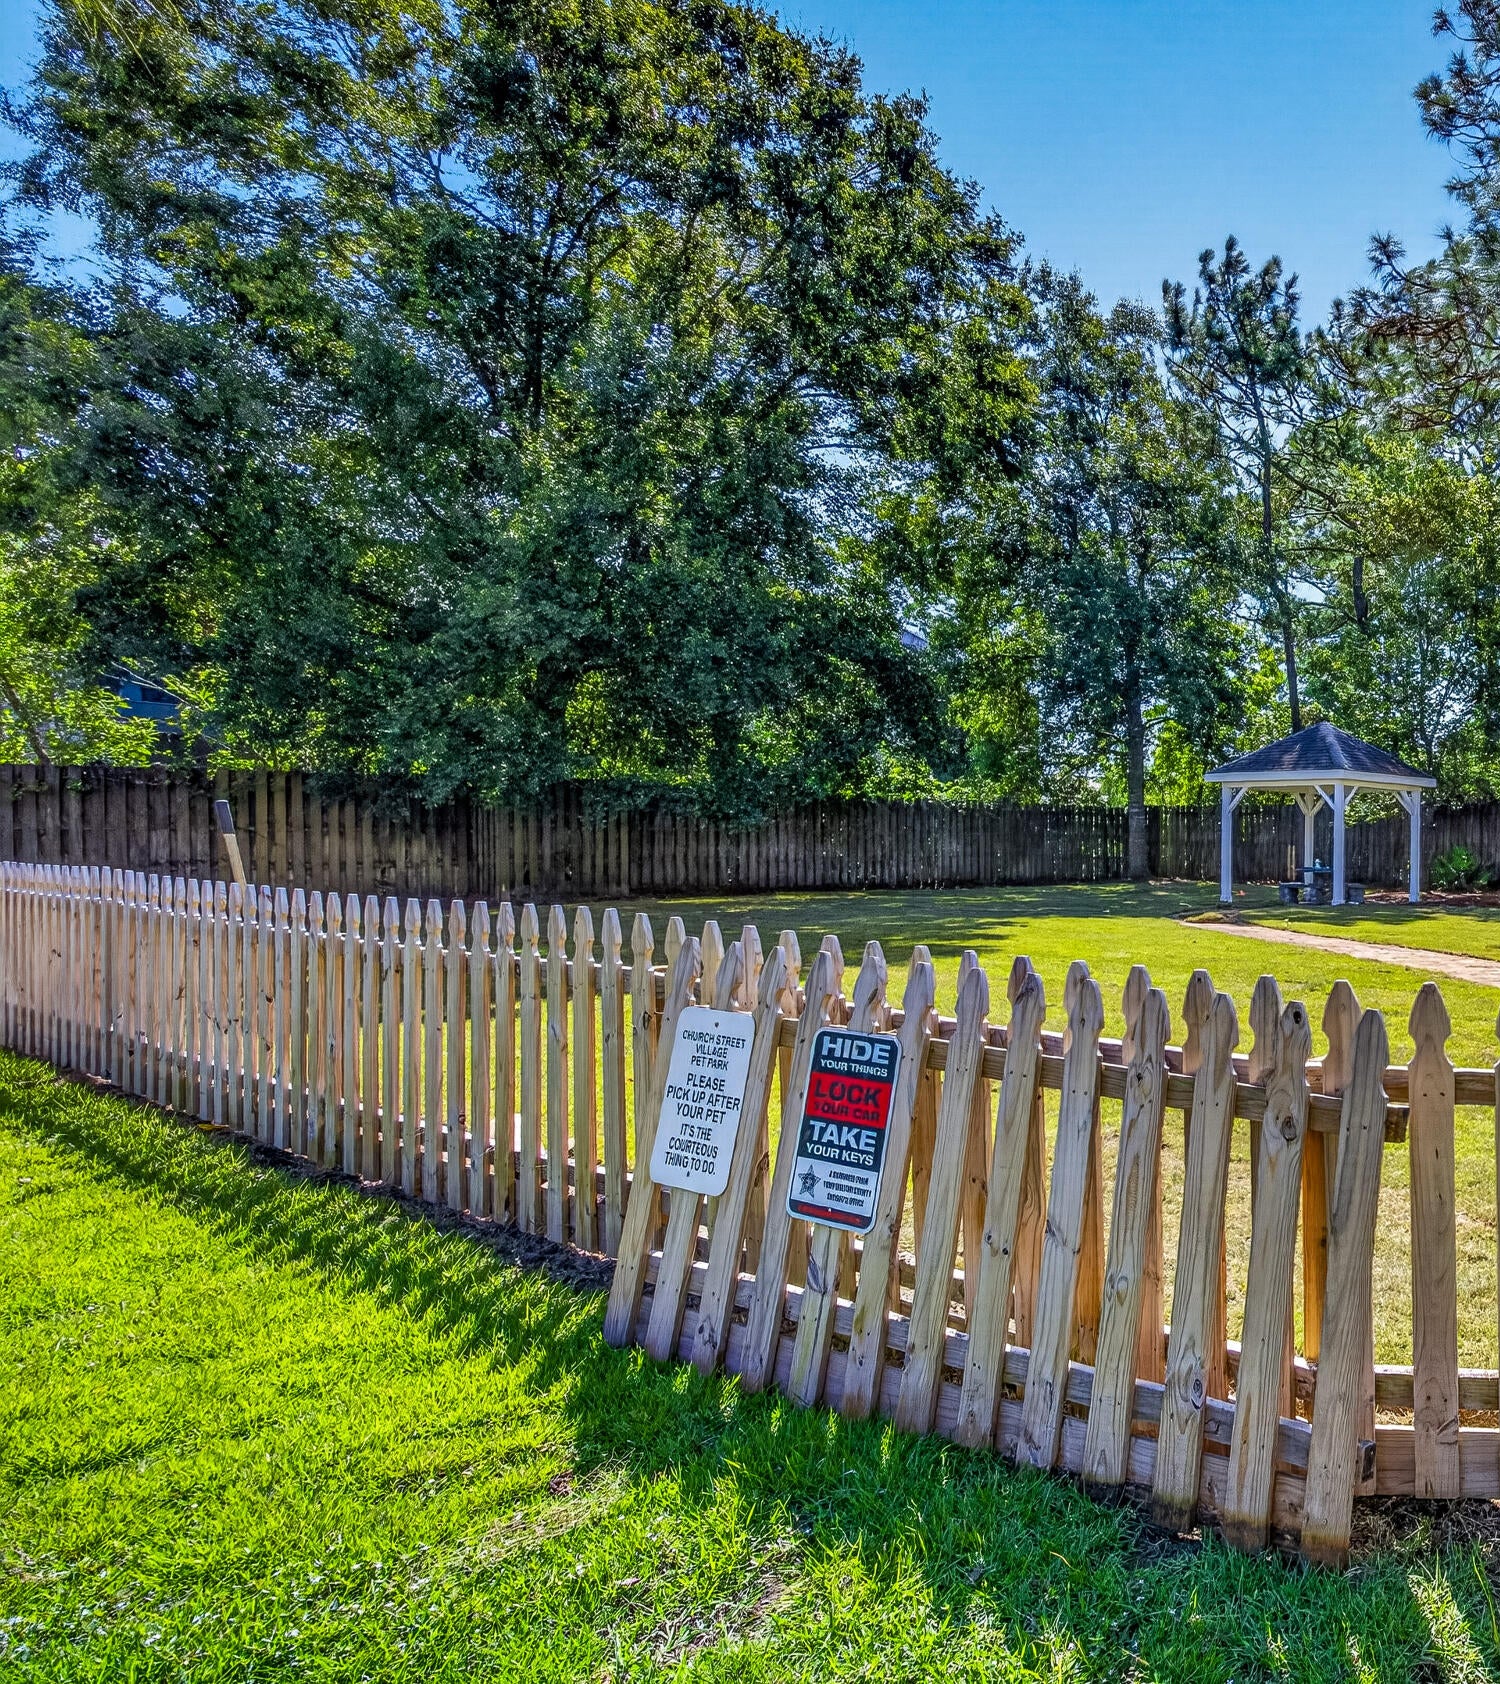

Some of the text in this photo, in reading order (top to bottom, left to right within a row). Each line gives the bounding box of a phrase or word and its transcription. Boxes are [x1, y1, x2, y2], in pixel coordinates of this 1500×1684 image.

[682, 1030, 746, 1049] CHURCH STREET
[822, 1036, 891, 1064] HIDE
[696, 1044, 728, 1058] VILLAGE
[691, 1055, 729, 1070] PET PARK
[821, 1059, 888, 1077] YOUR THINGS
[686, 1073, 725, 1092] PLEASE
[666, 1085, 740, 1111] PICK UP AFTER
[814, 1078, 883, 1109] LOCK
[677, 1103, 726, 1124] YOUR PET
[814, 1101, 879, 1122] YOUR CAR
[697, 1126, 712, 1141] THE
[810, 1120, 877, 1153] TAKE
[668, 1137, 718, 1159] COURTEOUS
[806, 1142, 874, 1166] YOUR KEYS
[665, 1151, 716, 1175] THING TO DO.
